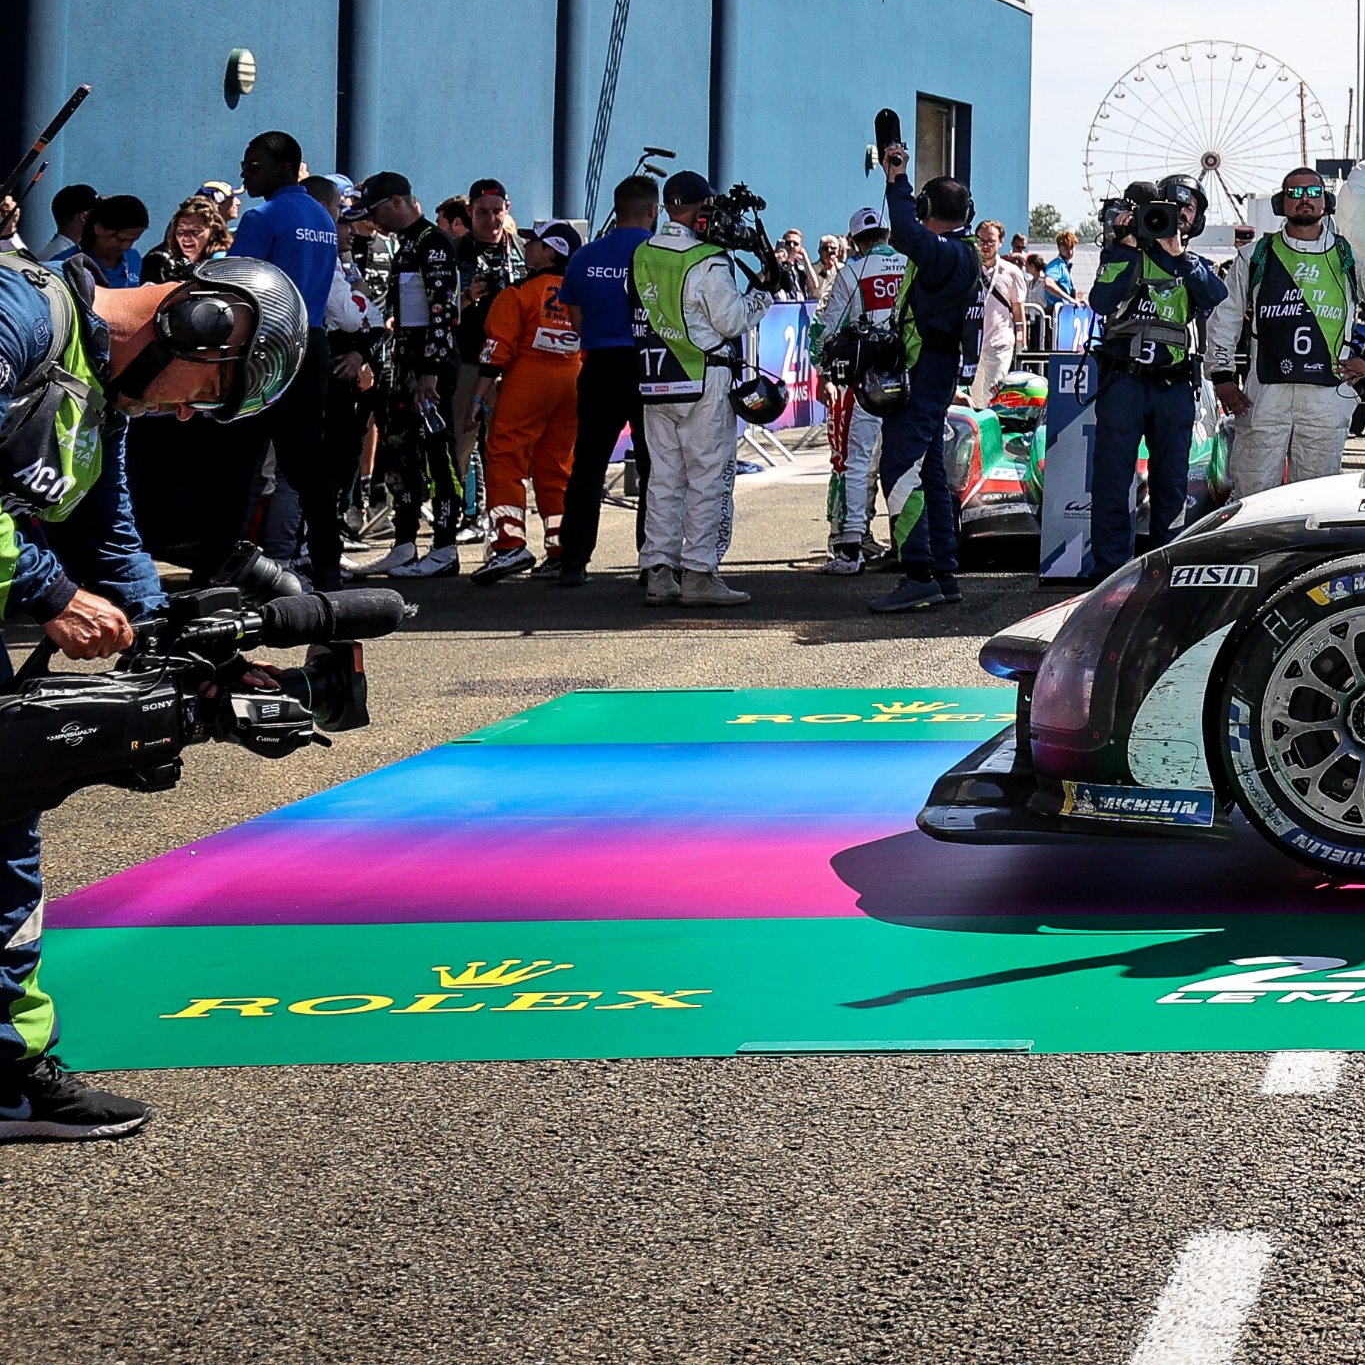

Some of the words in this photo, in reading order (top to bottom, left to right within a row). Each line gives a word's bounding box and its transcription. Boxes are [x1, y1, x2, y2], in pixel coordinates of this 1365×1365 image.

[1282, 289, 1303, 302] ACO
[1311, 289, 1326, 303] TV
[1260, 303, 1303, 318] PITLANE
[1294, 326, 1311, 355] 6
[1135, 341, 1155, 364] 3
[640, 348, 667, 377] 17
[1061, 371, 1087, 389] P2
[14, 457, 74, 503] ACO
[1173, 566, 1256, 586] AISIN
[142, 699, 174, 712] SONY
[256, 734, 280, 743] Canon
[1099, 796, 1199, 815] MICHELIN
[159, 988, 712, 1019] ROLEX
[1155, 990, 1267, 1004] LE
